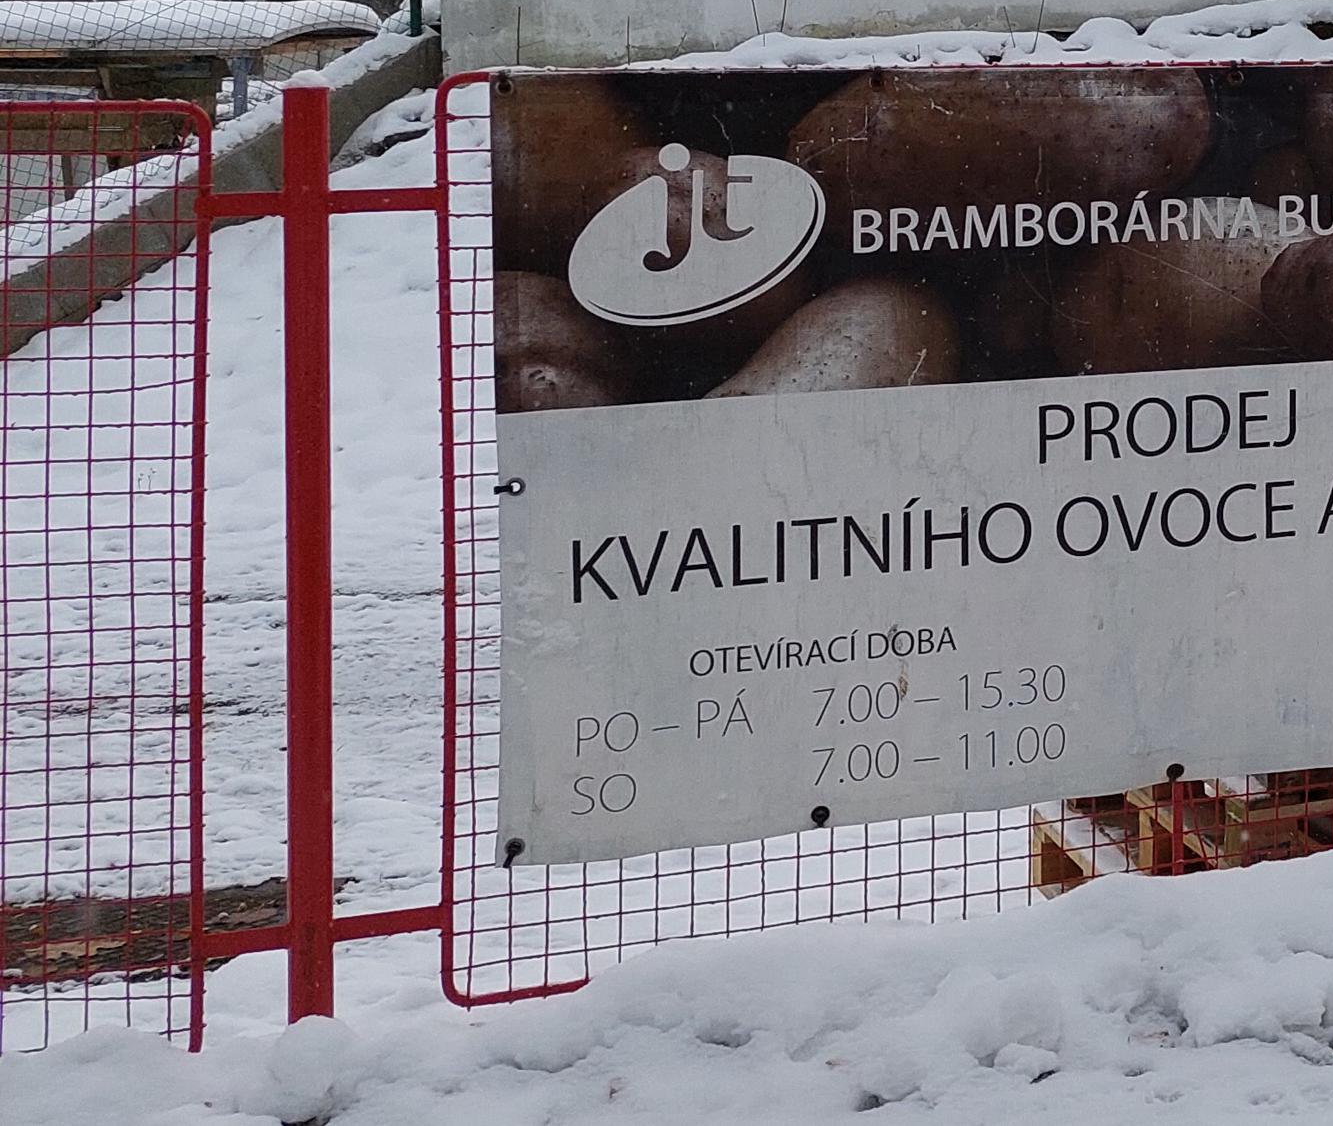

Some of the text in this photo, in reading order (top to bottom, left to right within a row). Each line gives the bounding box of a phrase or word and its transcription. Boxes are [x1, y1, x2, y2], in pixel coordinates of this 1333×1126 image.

[851, 189, 1263, 255] BRAMBORÁRNA
[1037, 388, 1298, 465] PRODEJ
[571, 496, 1033, 605] KVALITNÍHO
[1055, 479, 1297, 558] OVOCE
[688, 625, 958, 677] OTEVÍRACÍ DOBA
[575, 711, 640, 758] PO
[695, 687, 755, 740] PÁ
[811, 680, 902, 729] 7.00
[957, 664, 1067, 713] 15.30
[571, 772, 638, 816] SO
[811, 739, 902, 788] 7.00
[957, 722, 1067, 772] 11.00
